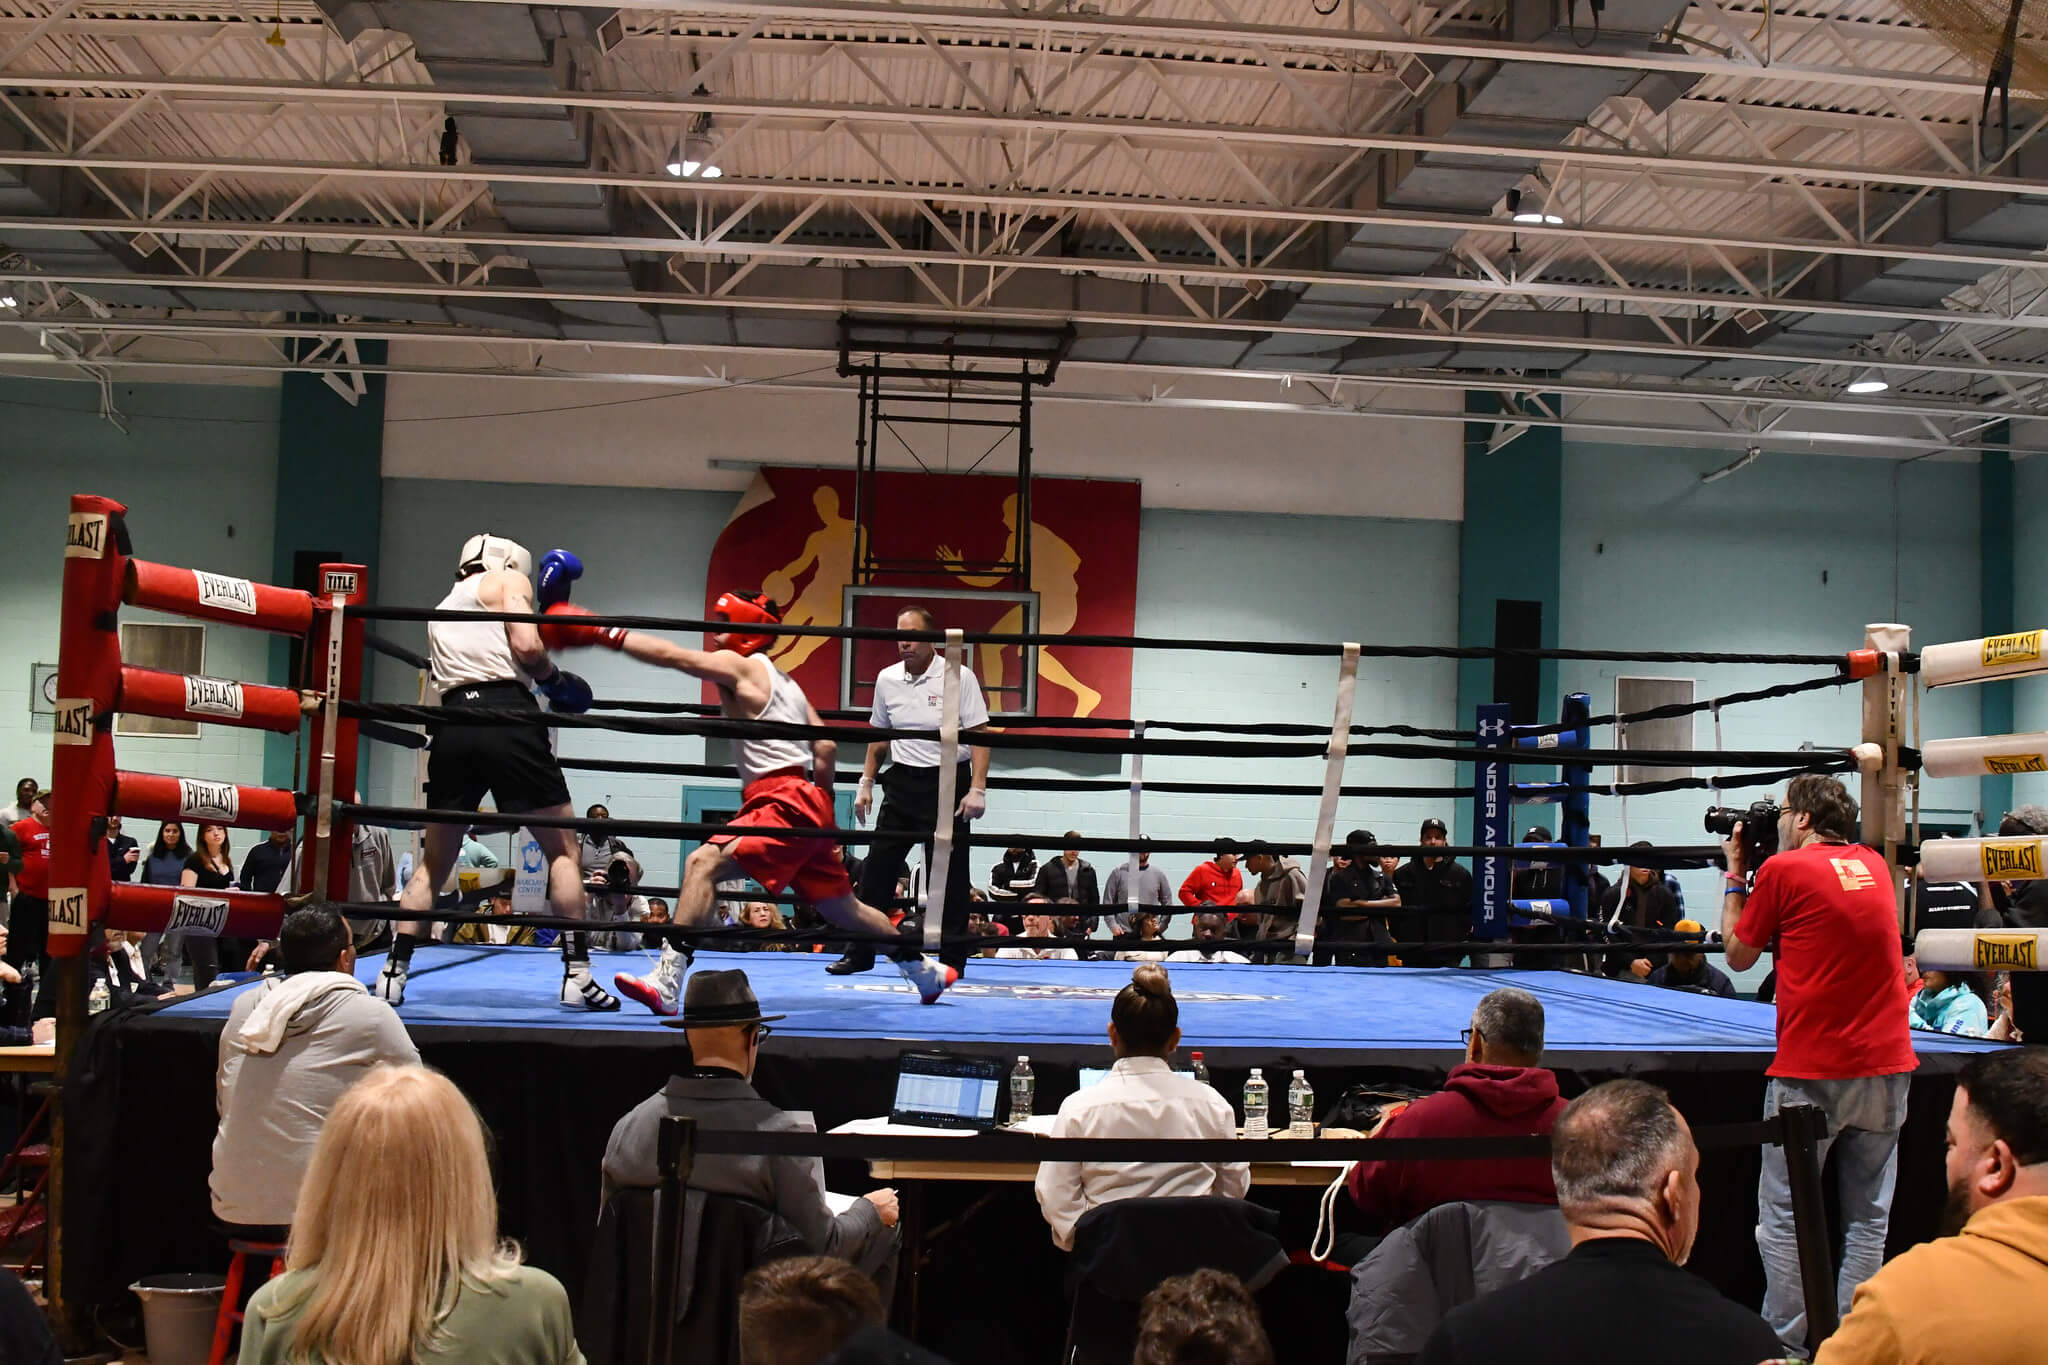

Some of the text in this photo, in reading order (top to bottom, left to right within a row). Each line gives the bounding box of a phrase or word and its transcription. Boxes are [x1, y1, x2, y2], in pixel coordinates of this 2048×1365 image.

[200, 574, 251, 607] EVERLAST
[327, 576, 354, 590] TITLE
[1986, 632, 2039, 662] EVERLAST
[329, 640, 338, 699] TITLE
[190, 678, 238, 712] EVERLAST
[1486, 743, 1497, 818] NDER
[184, 781, 233, 816] EVERLAST
[1985, 845, 2037, 875] EVERLAST
[169, 899, 226, 933] EVERLAST
[1977, 937, 2034, 969] EVERLAST
